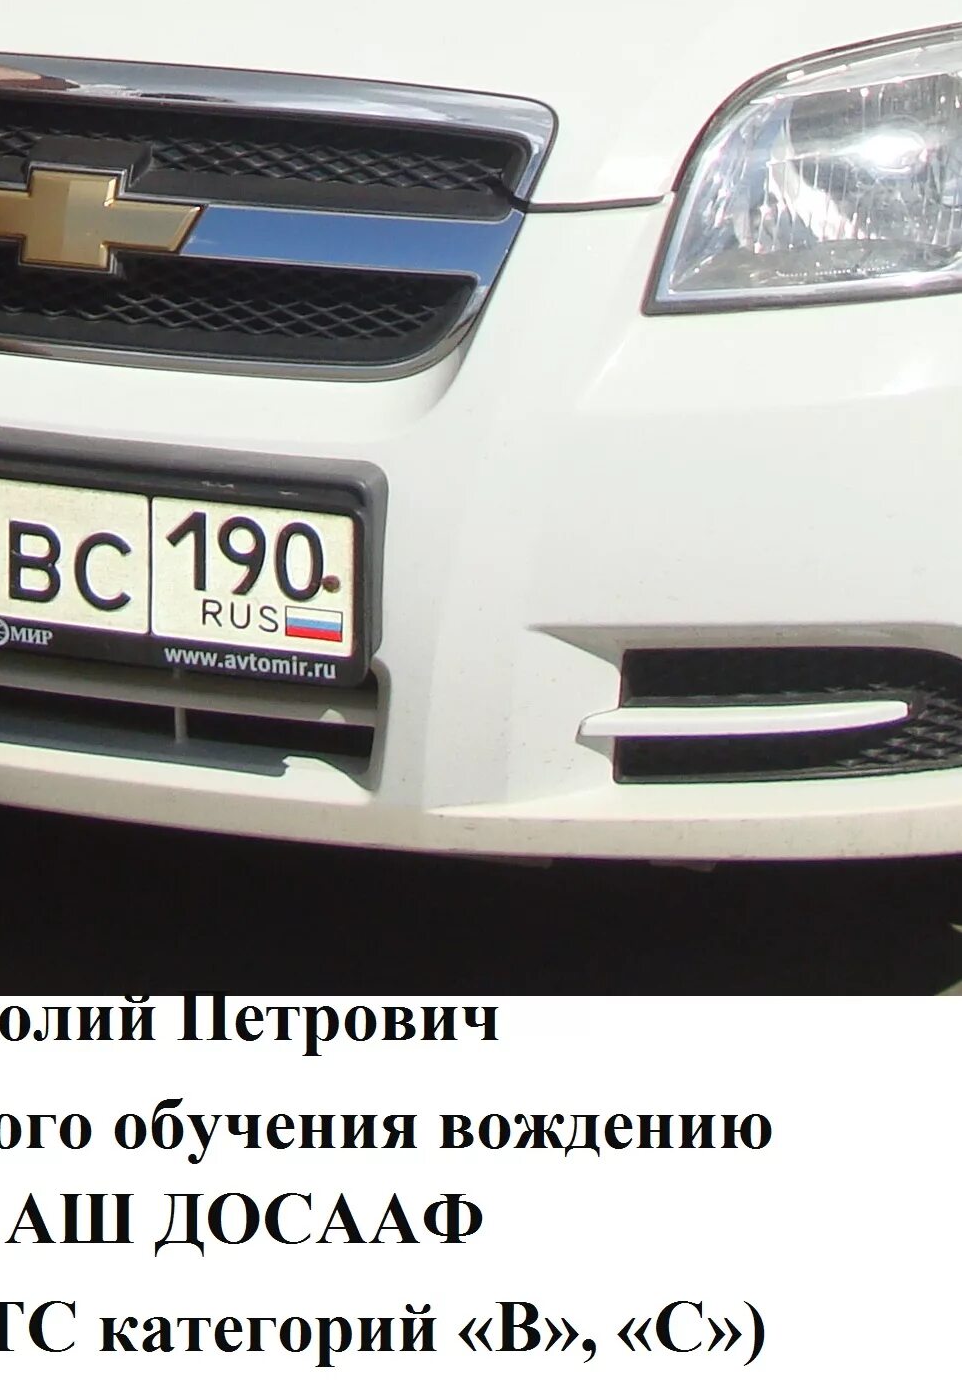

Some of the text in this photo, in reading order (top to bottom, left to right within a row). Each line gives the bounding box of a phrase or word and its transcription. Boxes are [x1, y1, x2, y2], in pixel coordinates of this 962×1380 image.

[166, 511, 324, 601] 190
[201, 599, 279, 633] RUS
[164, 646, 336, 680] www.avtomir.ru
